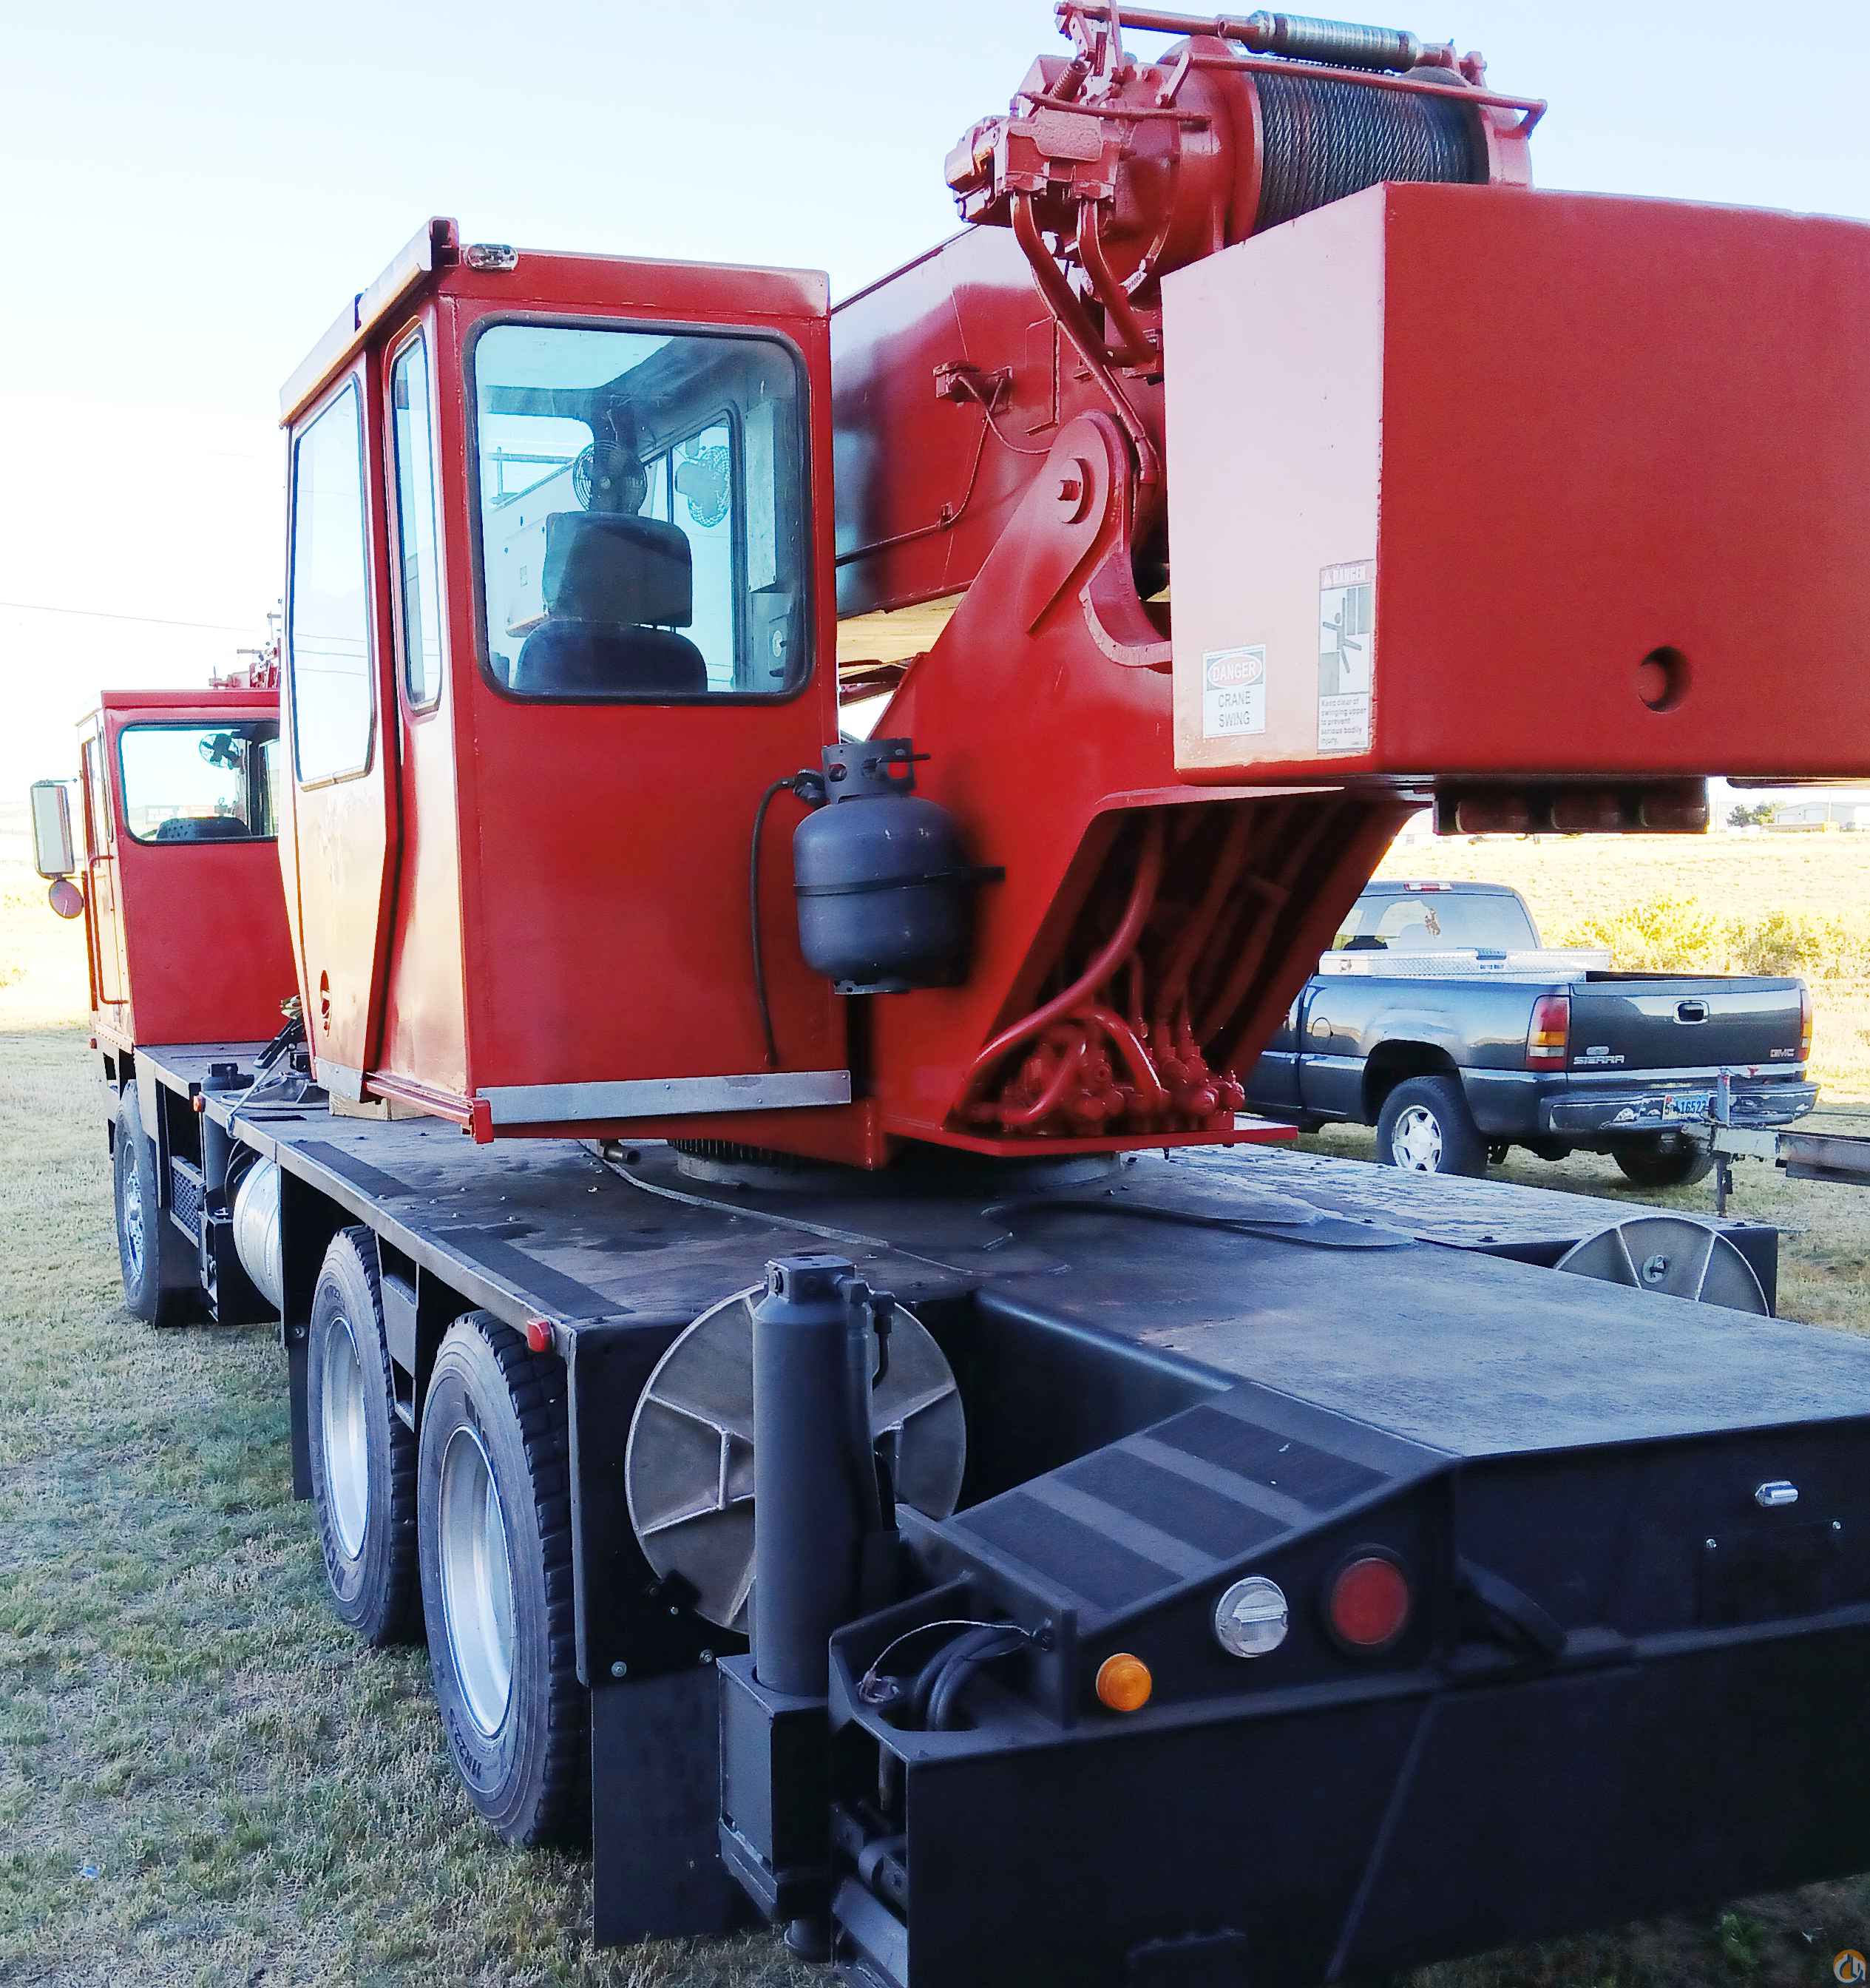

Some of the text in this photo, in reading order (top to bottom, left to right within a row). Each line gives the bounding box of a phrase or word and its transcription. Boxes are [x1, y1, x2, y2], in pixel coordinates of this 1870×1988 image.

[1213, 661, 1256, 682] DANGER
[1218, 690, 1251, 708] CRANE
[1219, 711, 1250, 728] SWING
[1573, 1055, 1625, 1065] SIERRA
[1769, 1049, 1795, 1058] GMC
